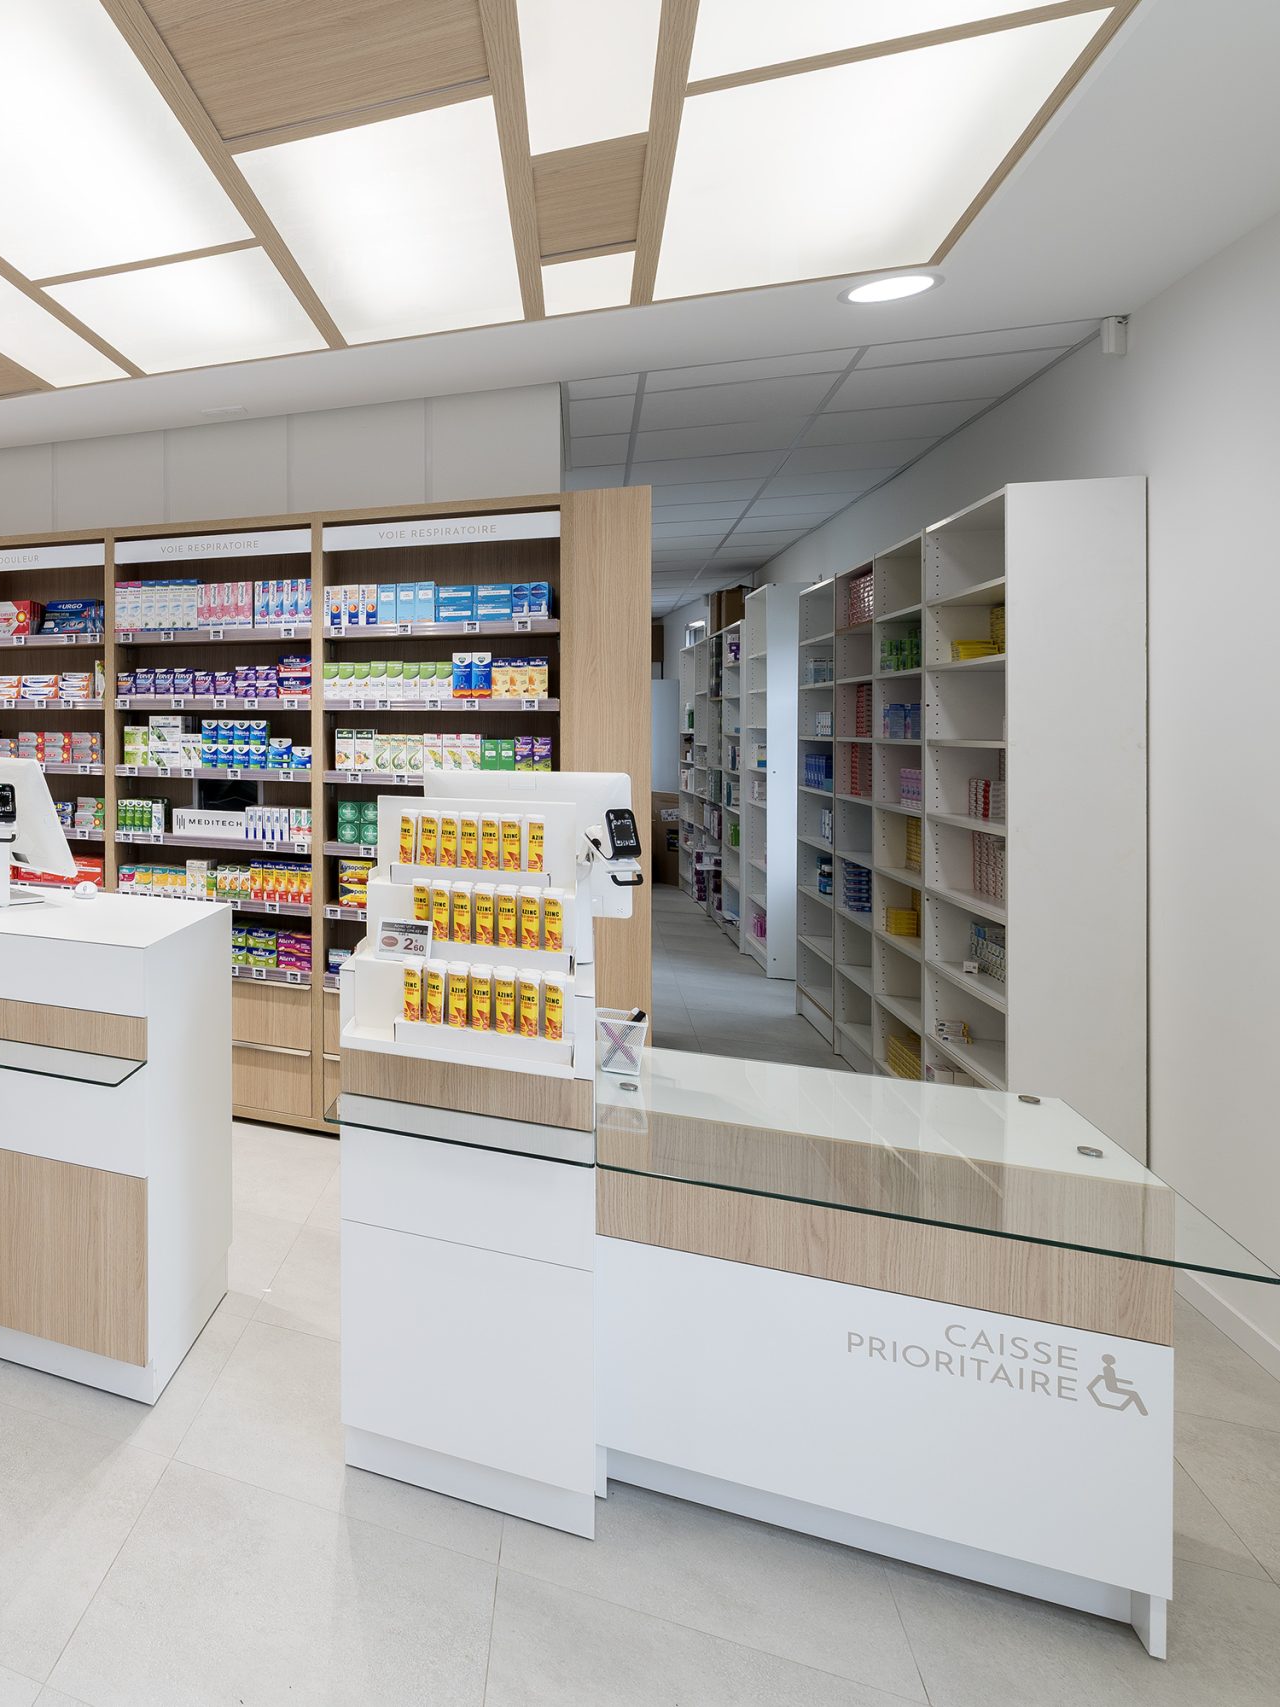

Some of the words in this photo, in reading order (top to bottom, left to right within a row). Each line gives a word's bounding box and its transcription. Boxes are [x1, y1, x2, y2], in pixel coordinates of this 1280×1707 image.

[378, 530, 406, 540] VOIE
[411, 524, 497, 538] RESPIRATOIRE
[160, 545, 184, 554] VOIE
[187, 540, 260, 552] RESPIRATOIRE
[188, 818, 243, 827] MEDITECH
[944, 1323, 1079, 1371] CAISSE
[847, 1330, 1079, 1402] PRIORITAIRE
